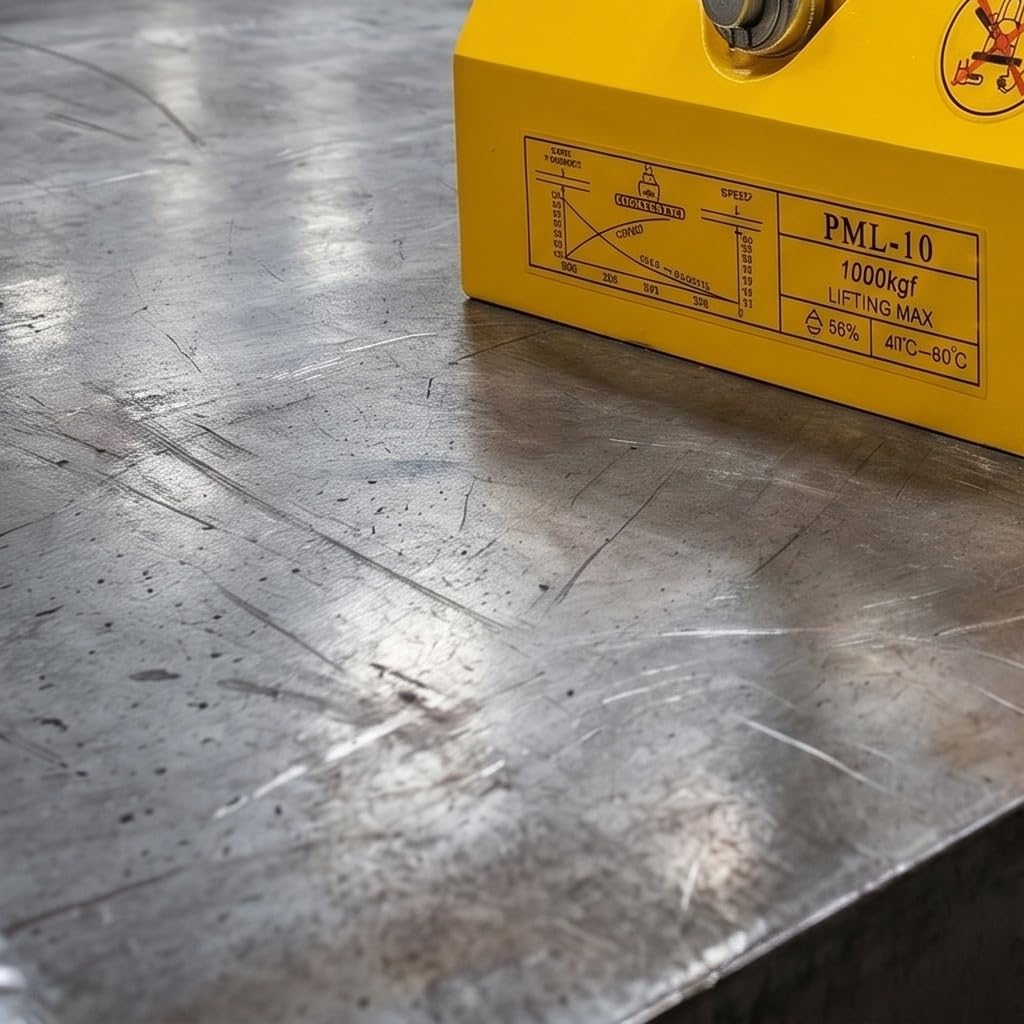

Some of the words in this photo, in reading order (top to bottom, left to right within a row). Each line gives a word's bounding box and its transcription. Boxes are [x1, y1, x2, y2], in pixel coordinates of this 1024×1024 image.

[823, 212, 933, 263] PML-10
[841, 260, 918, 299] 1000kgf
[828, 286, 891, 317] LIFTING
[896, 304, 933, 328] MAX
[829, 319, 860, 342] 56%
